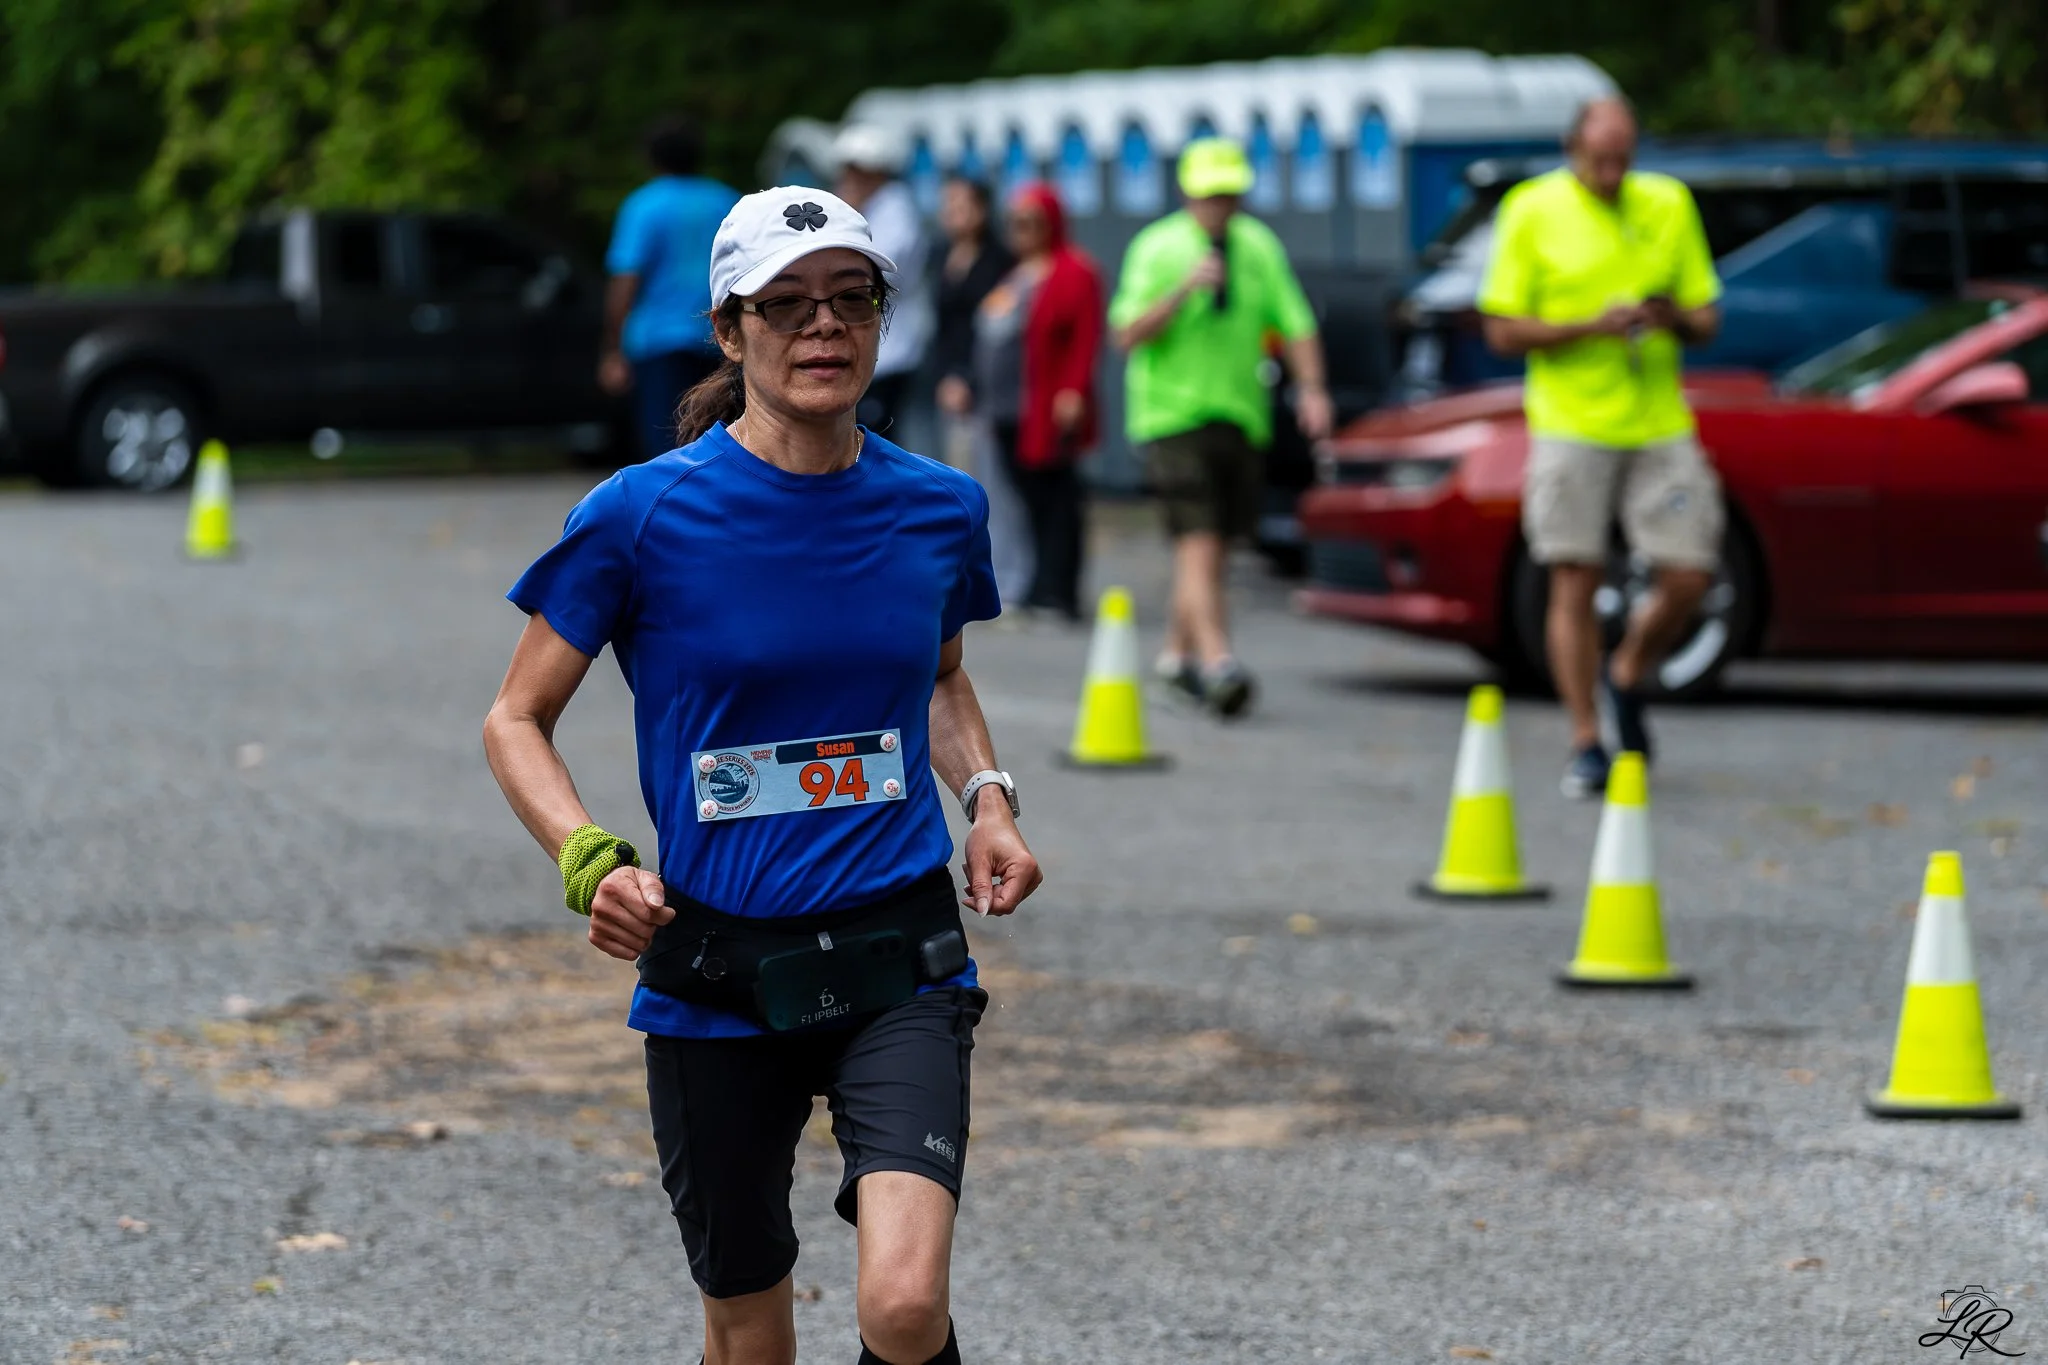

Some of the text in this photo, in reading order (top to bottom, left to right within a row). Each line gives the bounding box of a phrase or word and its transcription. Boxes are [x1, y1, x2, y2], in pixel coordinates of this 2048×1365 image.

[816, 741, 855, 757] Susan
[725, 755, 744, 765] SERIES
[799, 758, 870, 808] 94
